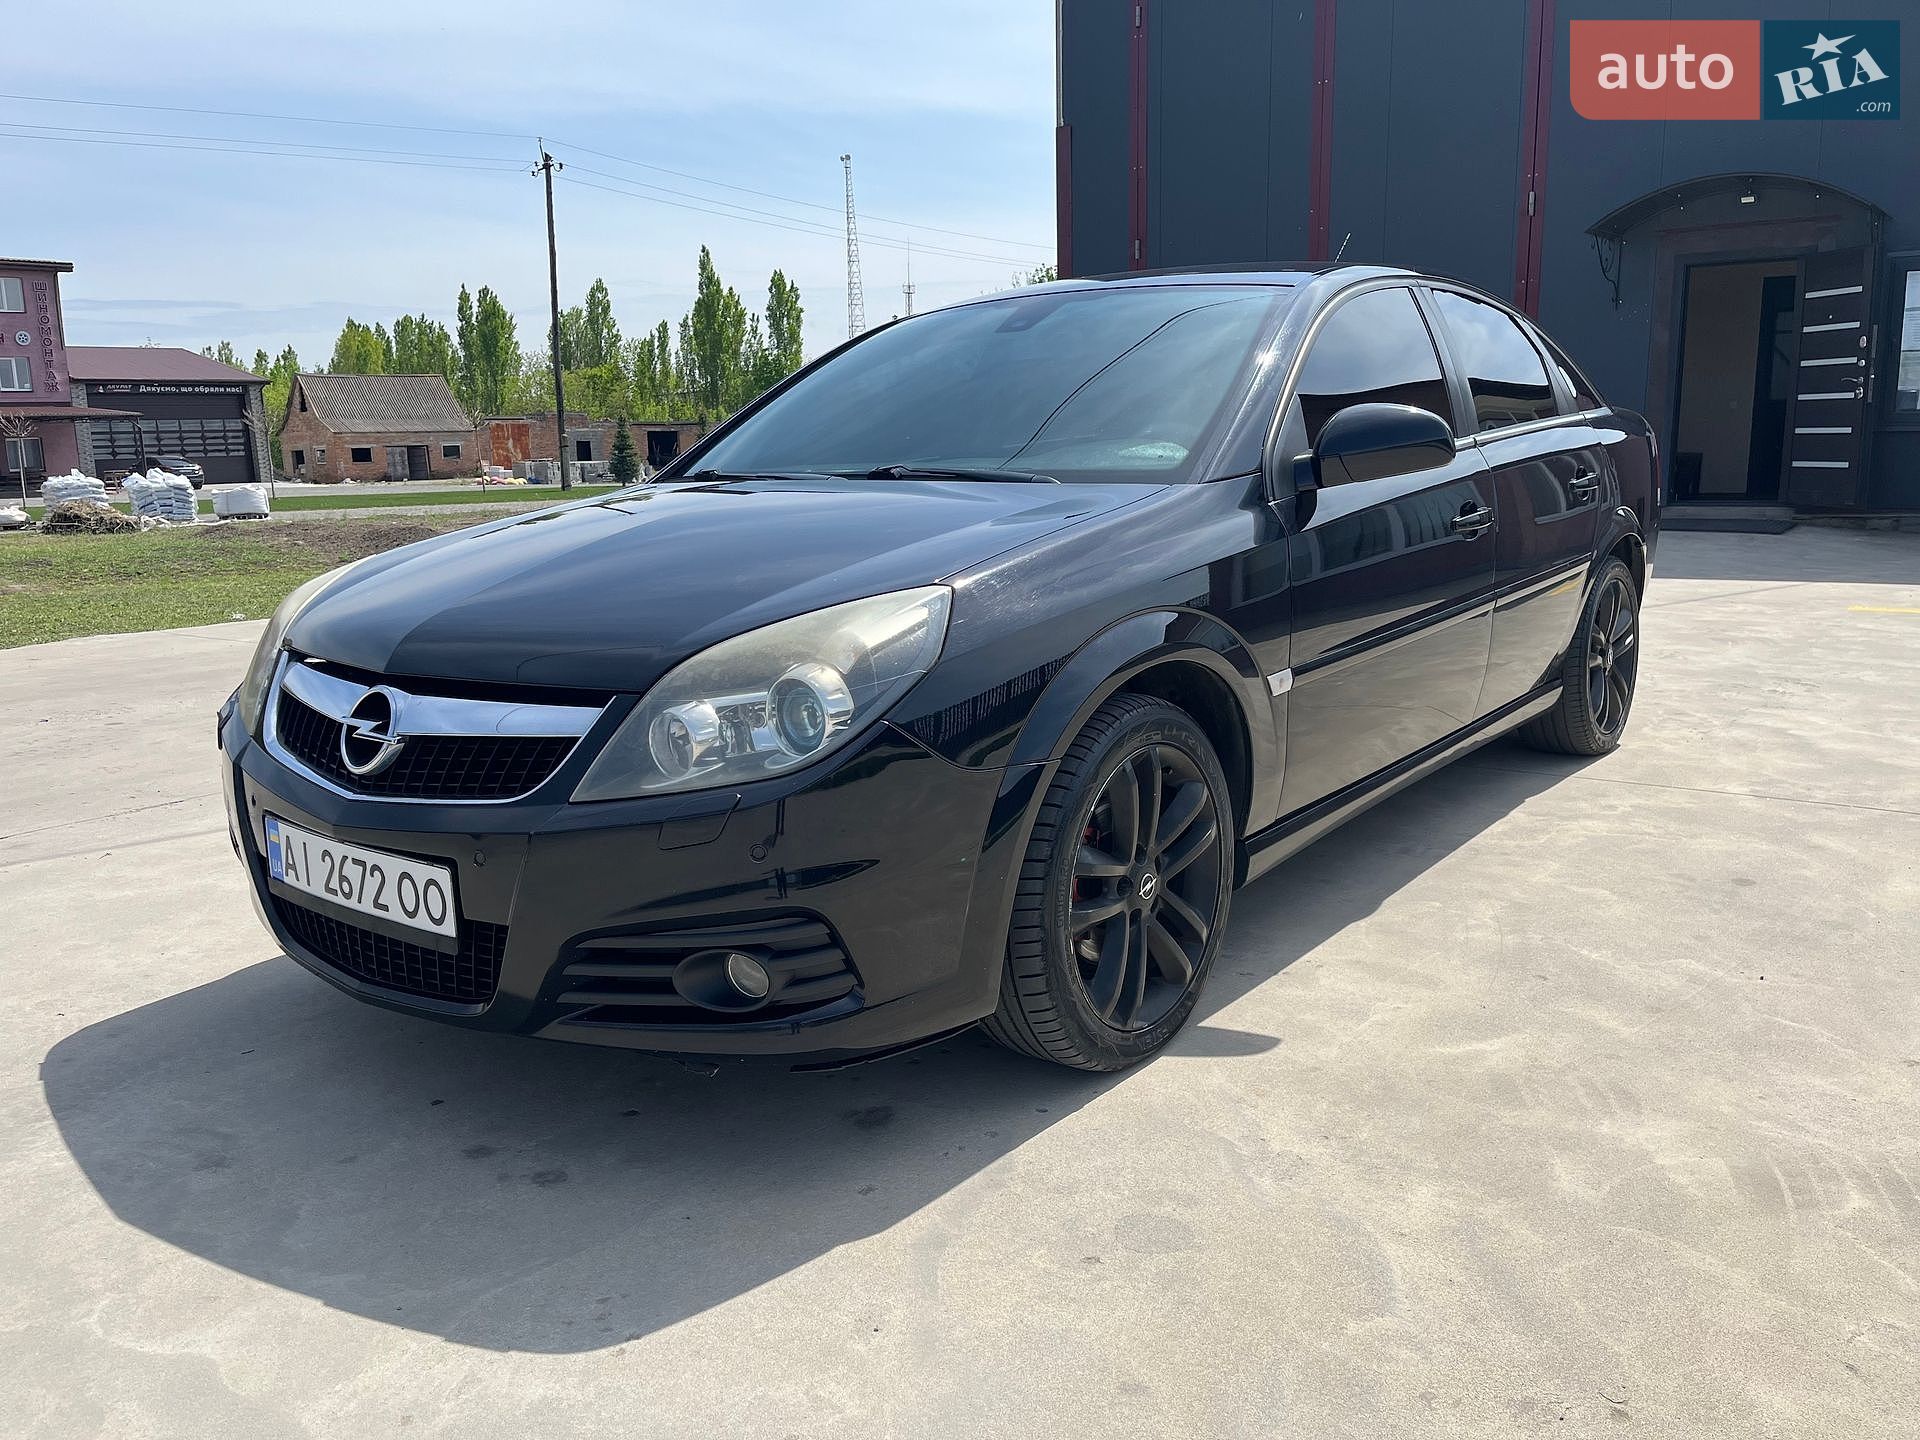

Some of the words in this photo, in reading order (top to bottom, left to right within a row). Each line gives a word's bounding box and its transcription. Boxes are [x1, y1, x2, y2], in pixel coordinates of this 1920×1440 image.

[33, 280, 60, 393] ШИНОМОНТАЖ
[272, 860, 283, 874] UA
[321, 849, 390, 913] 2672
